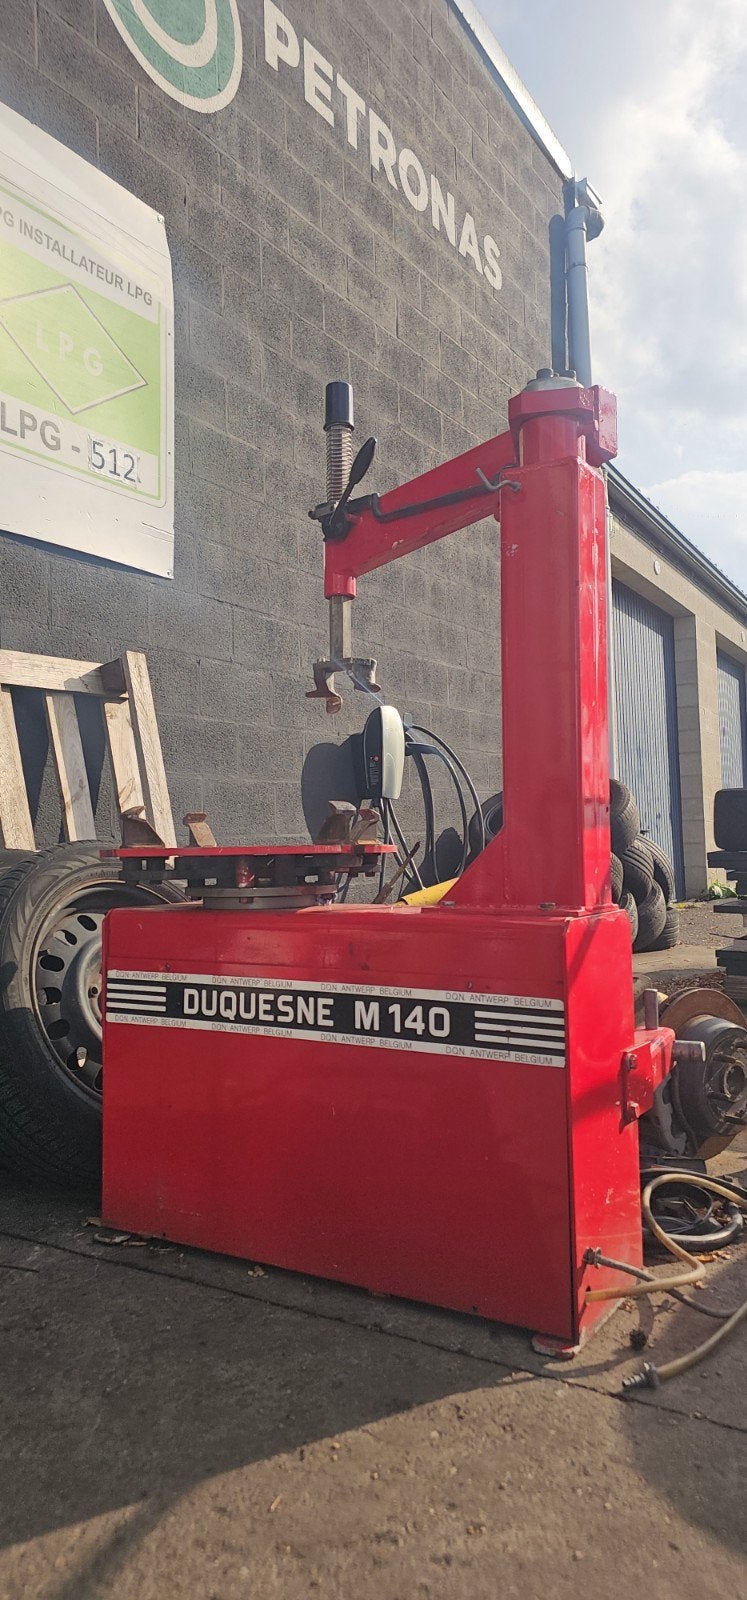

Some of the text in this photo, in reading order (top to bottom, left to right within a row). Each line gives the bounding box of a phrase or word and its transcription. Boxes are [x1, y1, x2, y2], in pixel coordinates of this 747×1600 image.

[263, 0, 502, 291] PETRONAS
[0, 206, 153, 307] G INSTALLATEUR LPG
[0, 401, 61, 452] LPG
[91, 440, 137, 483] 512
[132, 972, 159, 981] ANTWERP
[161, 974, 188, 982] BELGIUM
[230, 978, 261, 987] ANTWERP
[263, 979, 293, 989] BELGIUM
[341, 984, 376, 993] ANTWERP
[379, 986, 412, 997] BELGIUM
[469, 993, 509, 1004] ANTWERP
[513, 997, 552, 1008] BELGIUM
[183, 988, 451, 1038] DUQUESNE M 140
[131, 1016, 158, 1025] ANTWERP
[160, 1018, 187, 1027] BELGIUM
[230, 1024, 261, 1034] ANTWERP
[263, 1027, 293, 1038] BELGIUM
[341, 1034, 376, 1045] ANTWERP
[379, 1038, 412, 1050] BELGIUM
[469, 1048, 509, 1060] ANTWERP
[514, 1053, 553, 1065] BELGIUM
